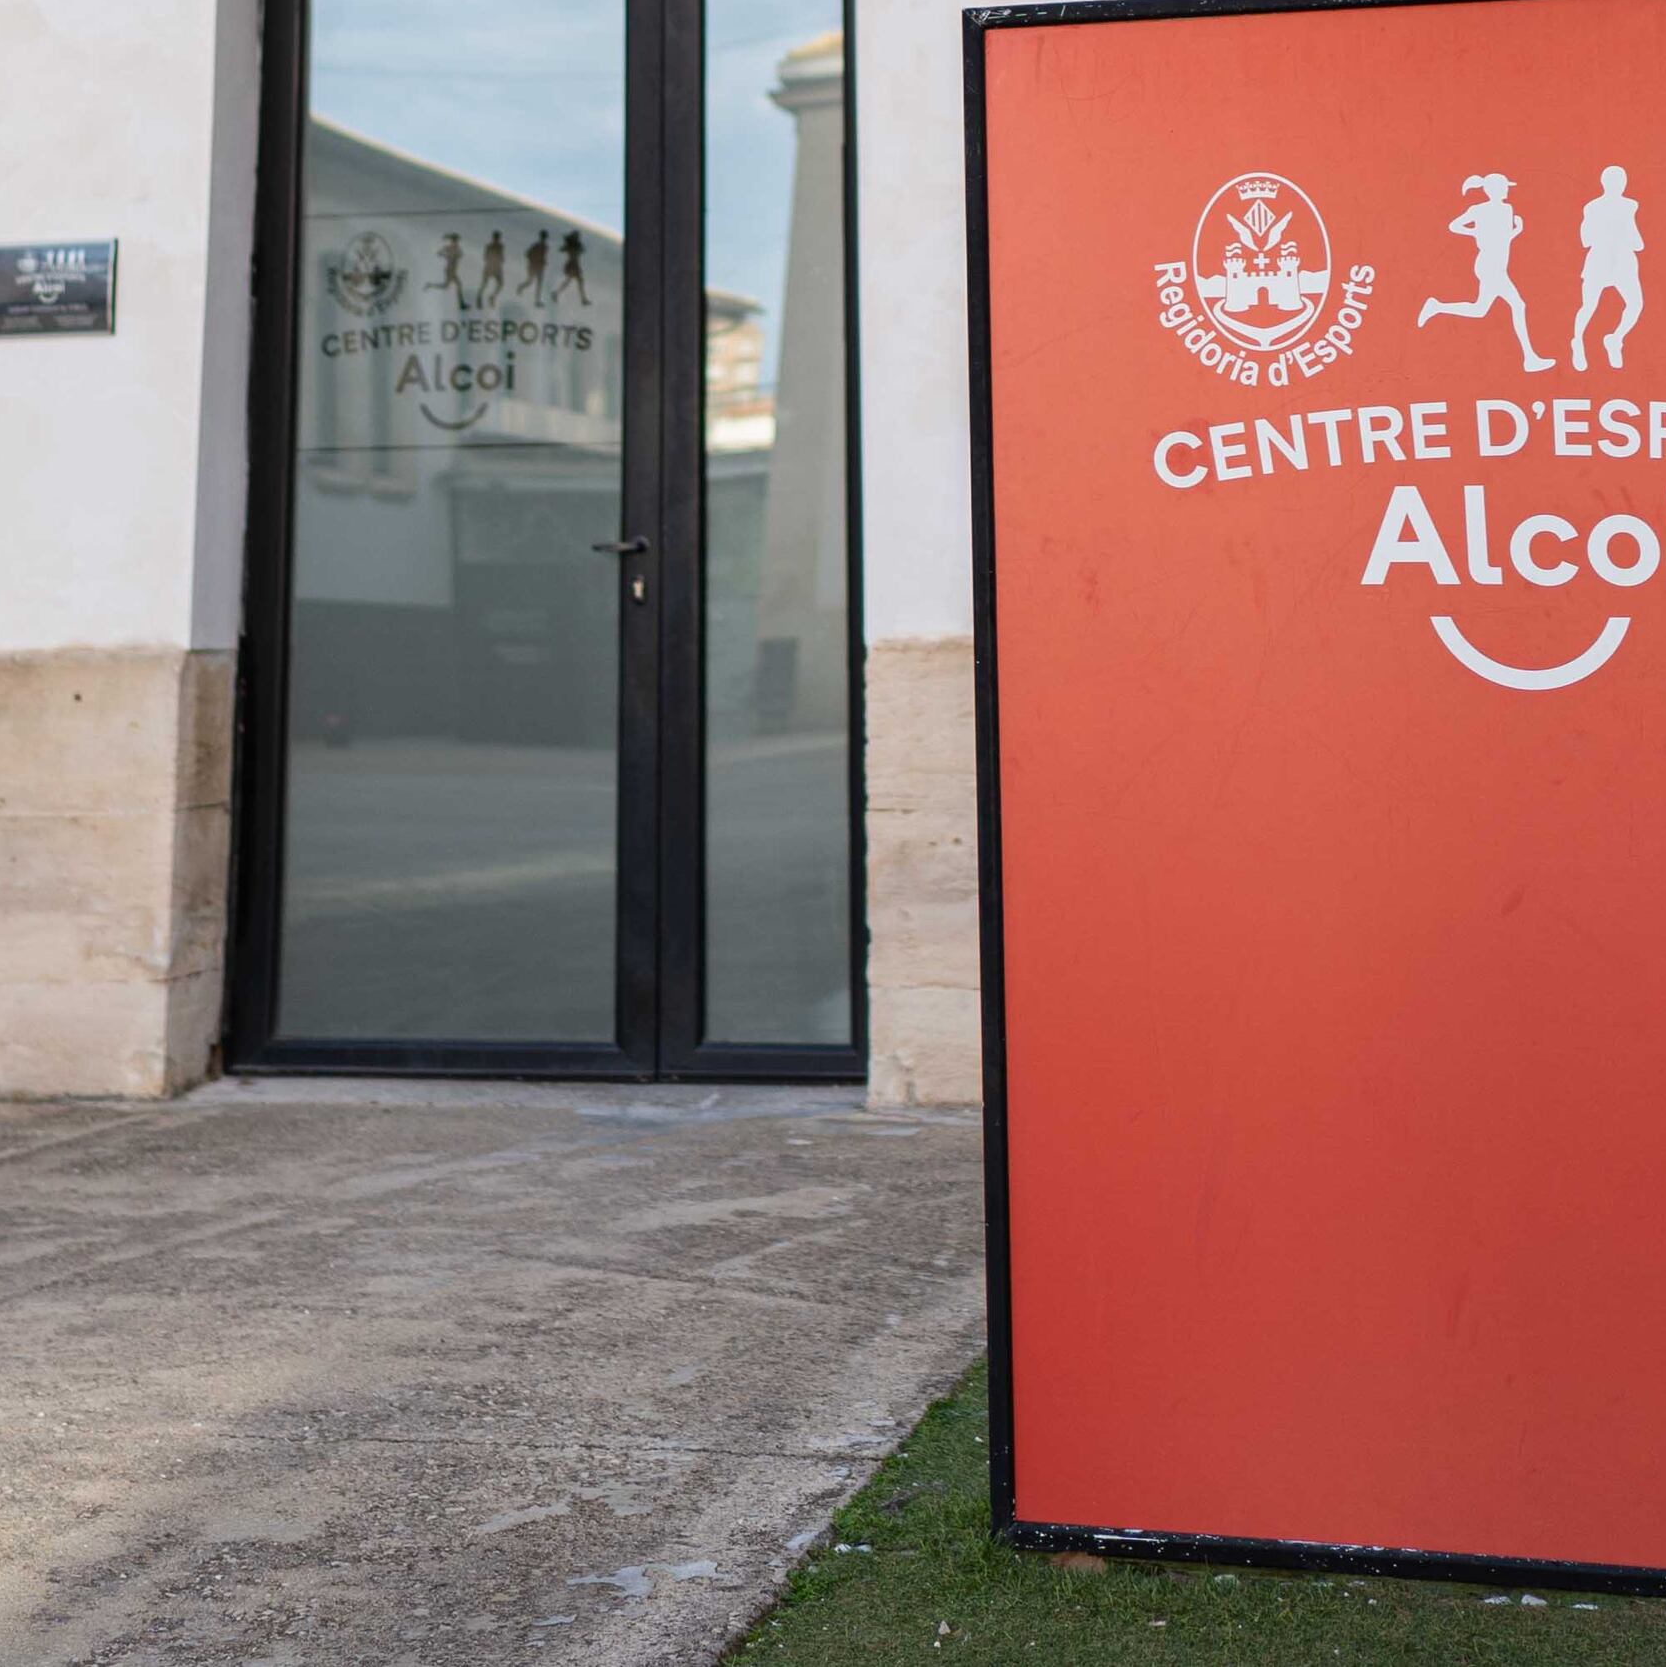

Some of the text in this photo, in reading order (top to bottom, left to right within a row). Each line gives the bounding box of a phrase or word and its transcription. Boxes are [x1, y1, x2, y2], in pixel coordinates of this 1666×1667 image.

[323, 321, 592, 357] CENTRE D'ESPORTS
[1154, 261, 1375, 386] Regidoria d'Esports
[396, 351, 515, 393] Alcoi
[1153, 402, 1450, 489] CENTRE
